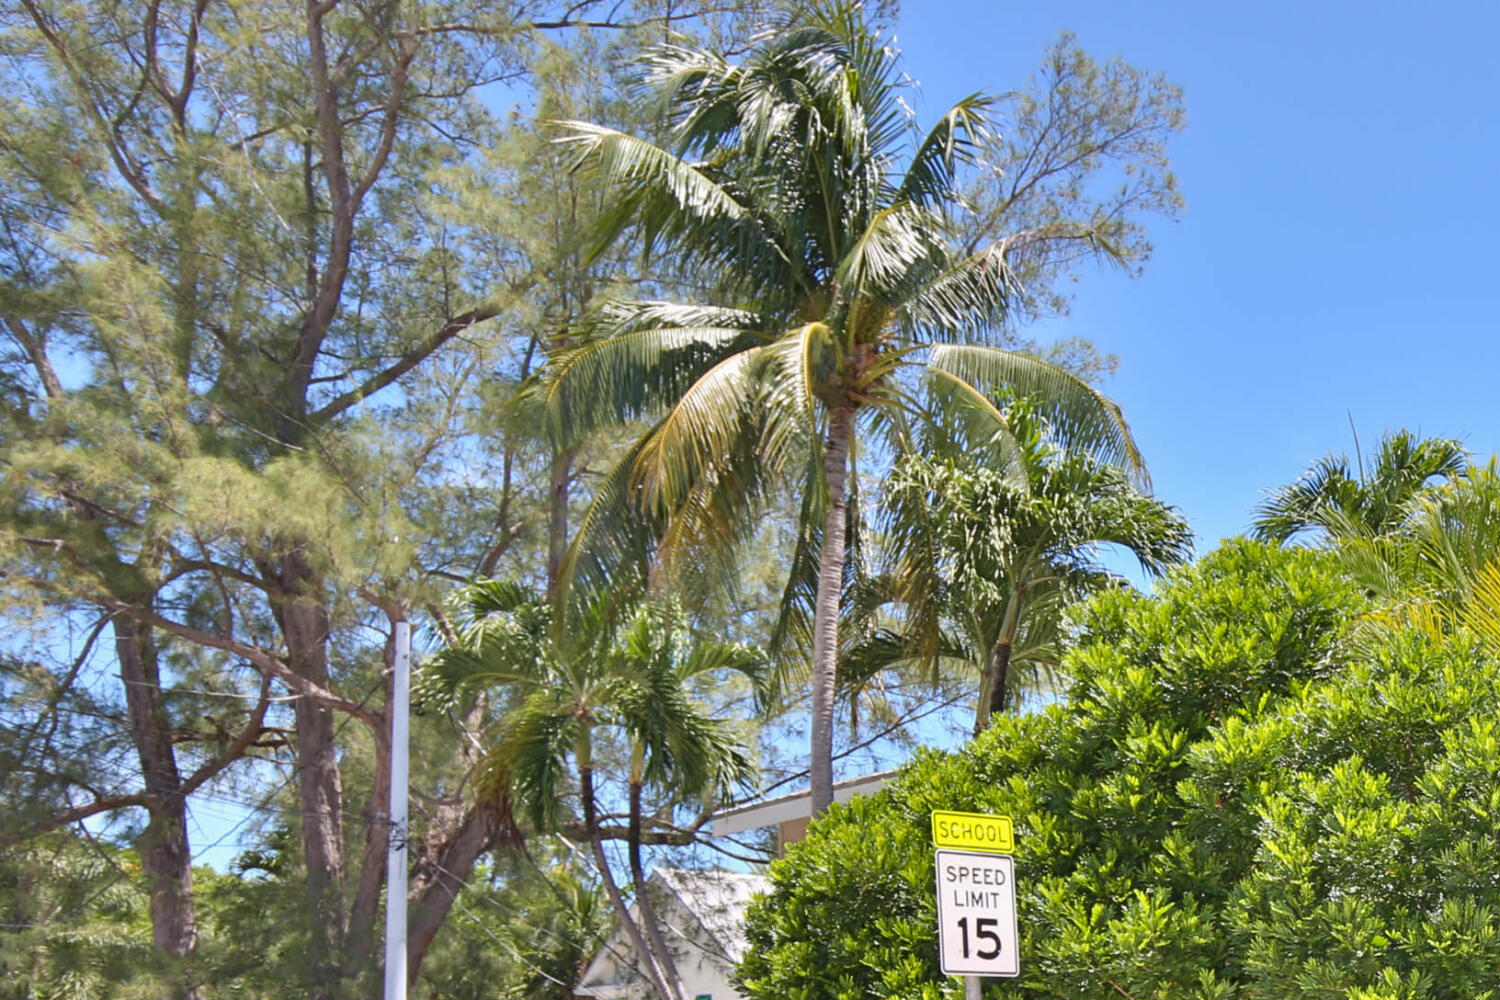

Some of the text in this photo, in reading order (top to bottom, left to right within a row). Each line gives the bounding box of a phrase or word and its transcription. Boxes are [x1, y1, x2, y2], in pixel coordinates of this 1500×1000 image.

[938, 820, 1008, 844] SCHOOL
[946, 865, 1006, 887] SPEED
[953, 890, 1000, 910] LIMIT
[957, 917, 1002, 961] 15
